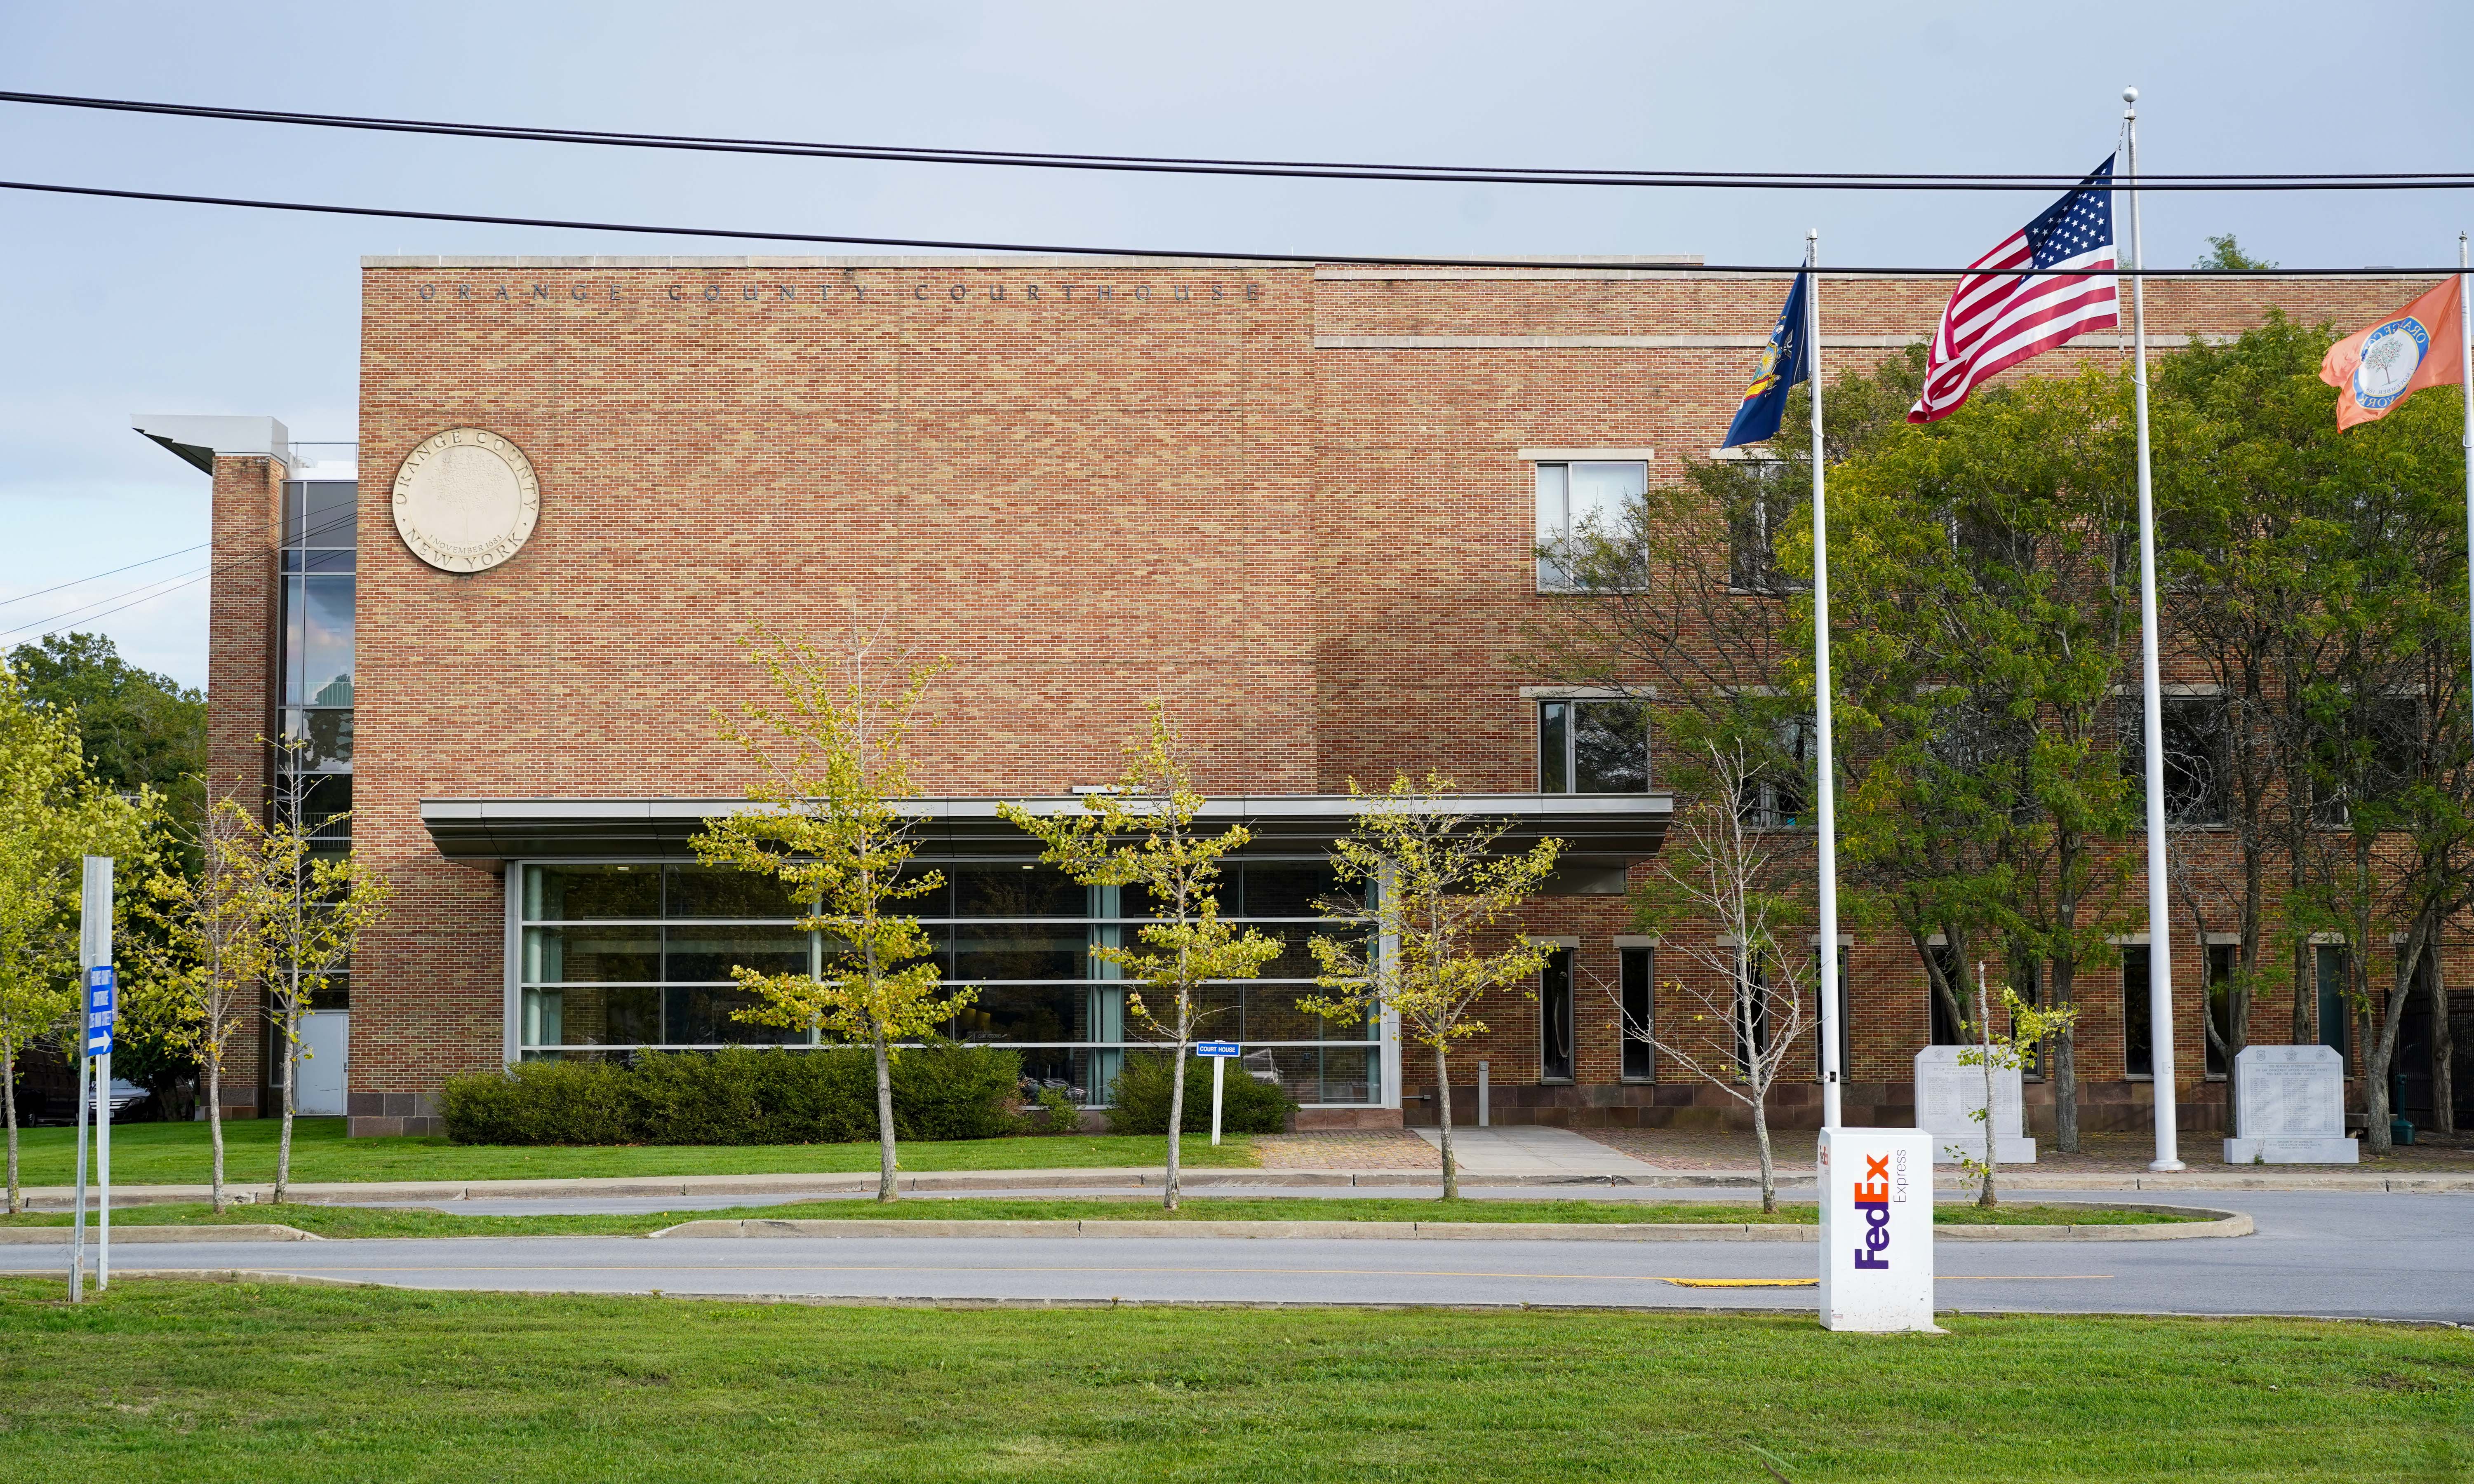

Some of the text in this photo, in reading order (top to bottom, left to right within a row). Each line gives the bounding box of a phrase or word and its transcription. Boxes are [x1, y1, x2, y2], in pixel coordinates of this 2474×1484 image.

[420, 284, 1259, 301] ORANGE COUNTY COURTHOUSE
[395, 431, 536, 511] ORANGE COUNTY
[404, 528, 523, 570] NEW YORK
[433, 538, 484, 554] NOVEMBER
[485, 535, 503, 549] 1683
[1819, 1145, 1829, 1166] FedEx
[1893, 1149, 1909, 1202] Express
[1855, 1154, 1890, 1269] FedEx
